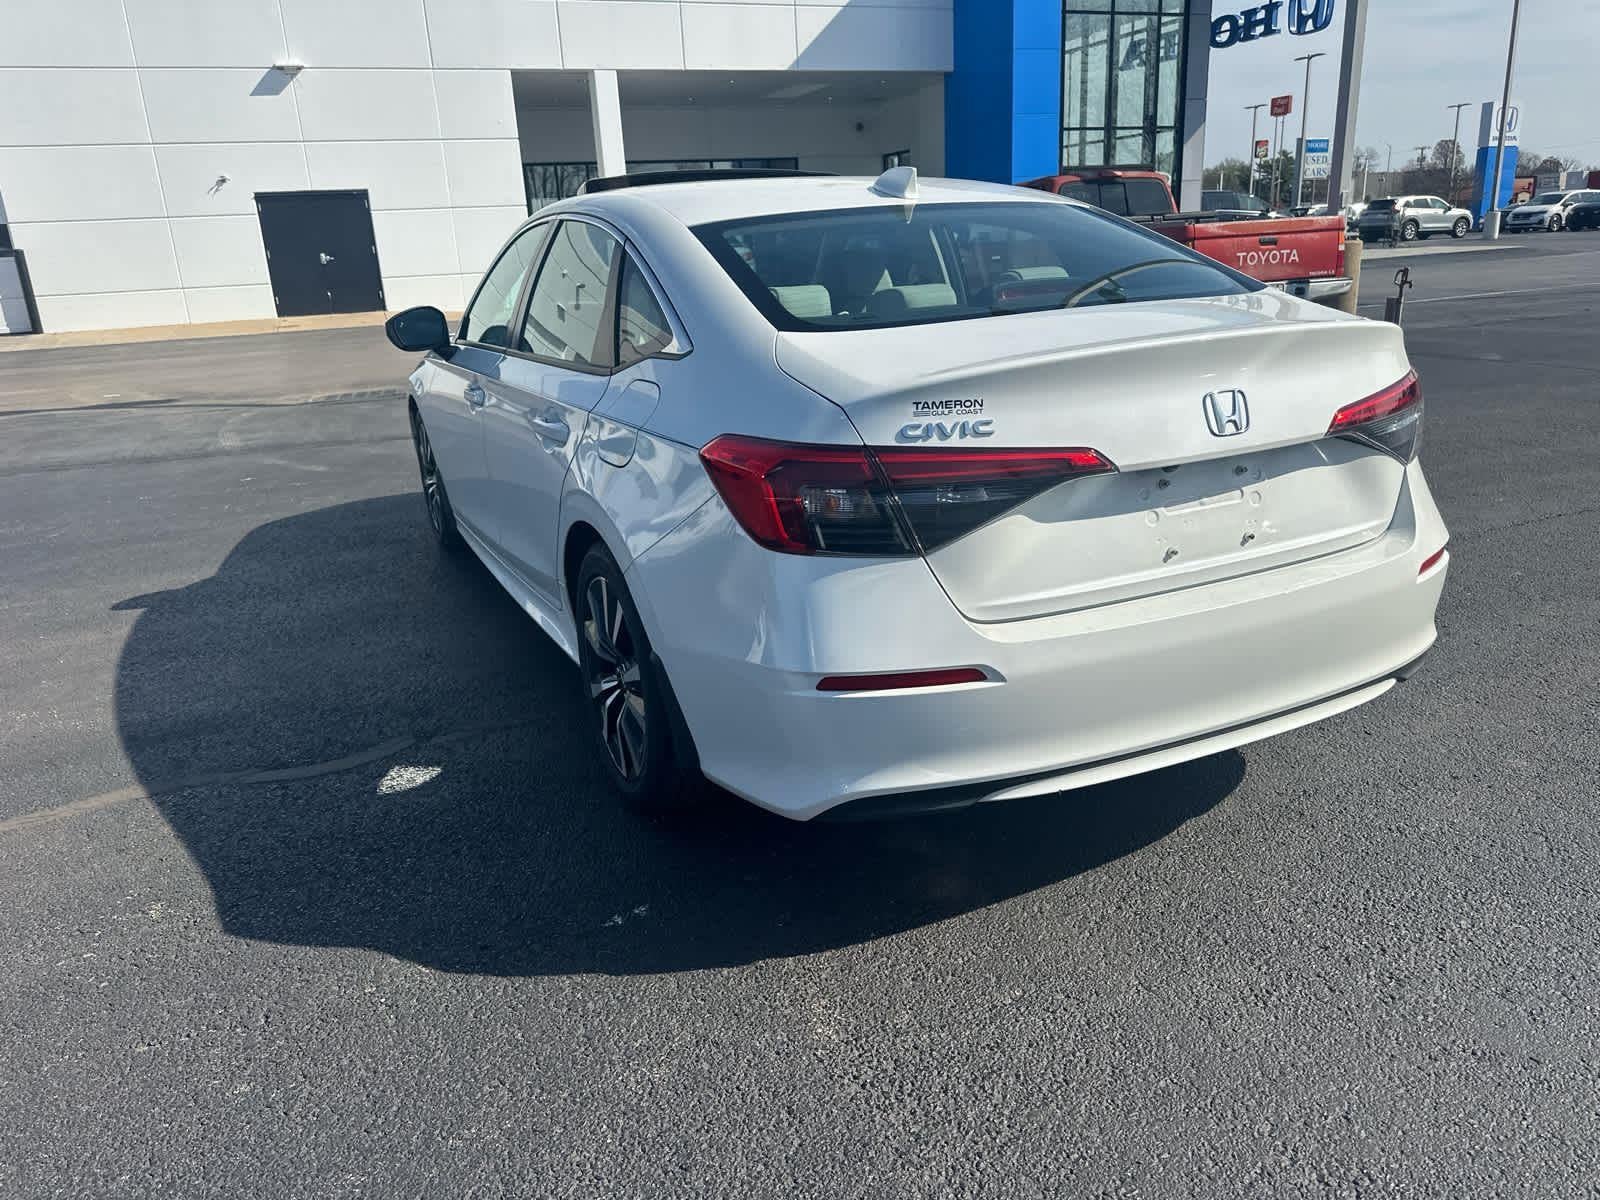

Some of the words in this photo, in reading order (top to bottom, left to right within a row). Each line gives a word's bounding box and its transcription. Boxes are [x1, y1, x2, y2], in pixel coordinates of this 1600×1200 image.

[1305, 155, 1328, 165] USED
[1304, 167, 1328, 177] CARS
[1236, 248, 1299, 266] TOYOTA
[912, 399, 984, 410] TAMERON
[931, 409, 953, 417] GULF
[956, 408, 984, 416] COAST
[897, 419, 994, 442] CIVIC
